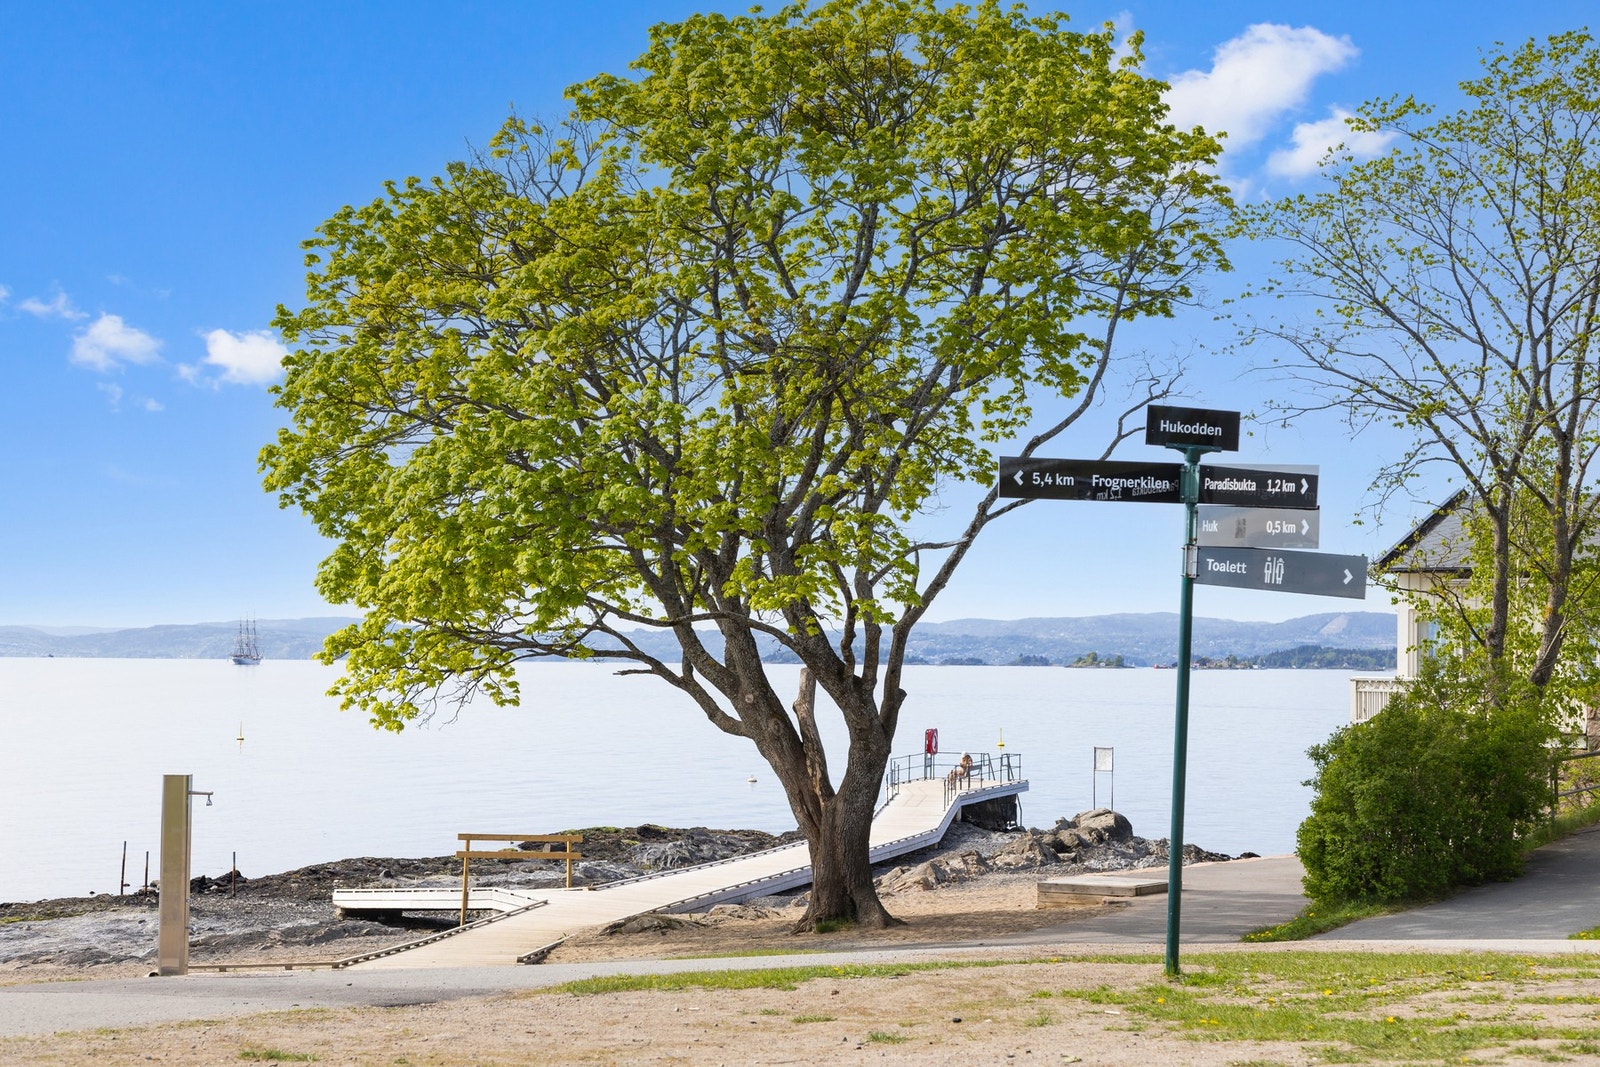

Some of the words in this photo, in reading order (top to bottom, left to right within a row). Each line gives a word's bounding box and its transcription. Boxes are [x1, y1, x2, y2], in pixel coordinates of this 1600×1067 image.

[1160, 420, 1222, 436] Hukodden
[1032, 472, 1053, 487] 5,4
[1055, 473, 1075, 486] km
[1092, 474, 1170, 491] Frognerkilen
[1204, 478, 1256, 491] Paradisbukta
[1266, 479, 1281, 494] 1,2
[1282, 480, 1296, 492] km
[1202, 520, 1219, 532] Huk
[1266, 521, 1281, 536] 0,5
[1282, 521, 1296, 533] km
[1206, 558, 1248, 574] Toalett
